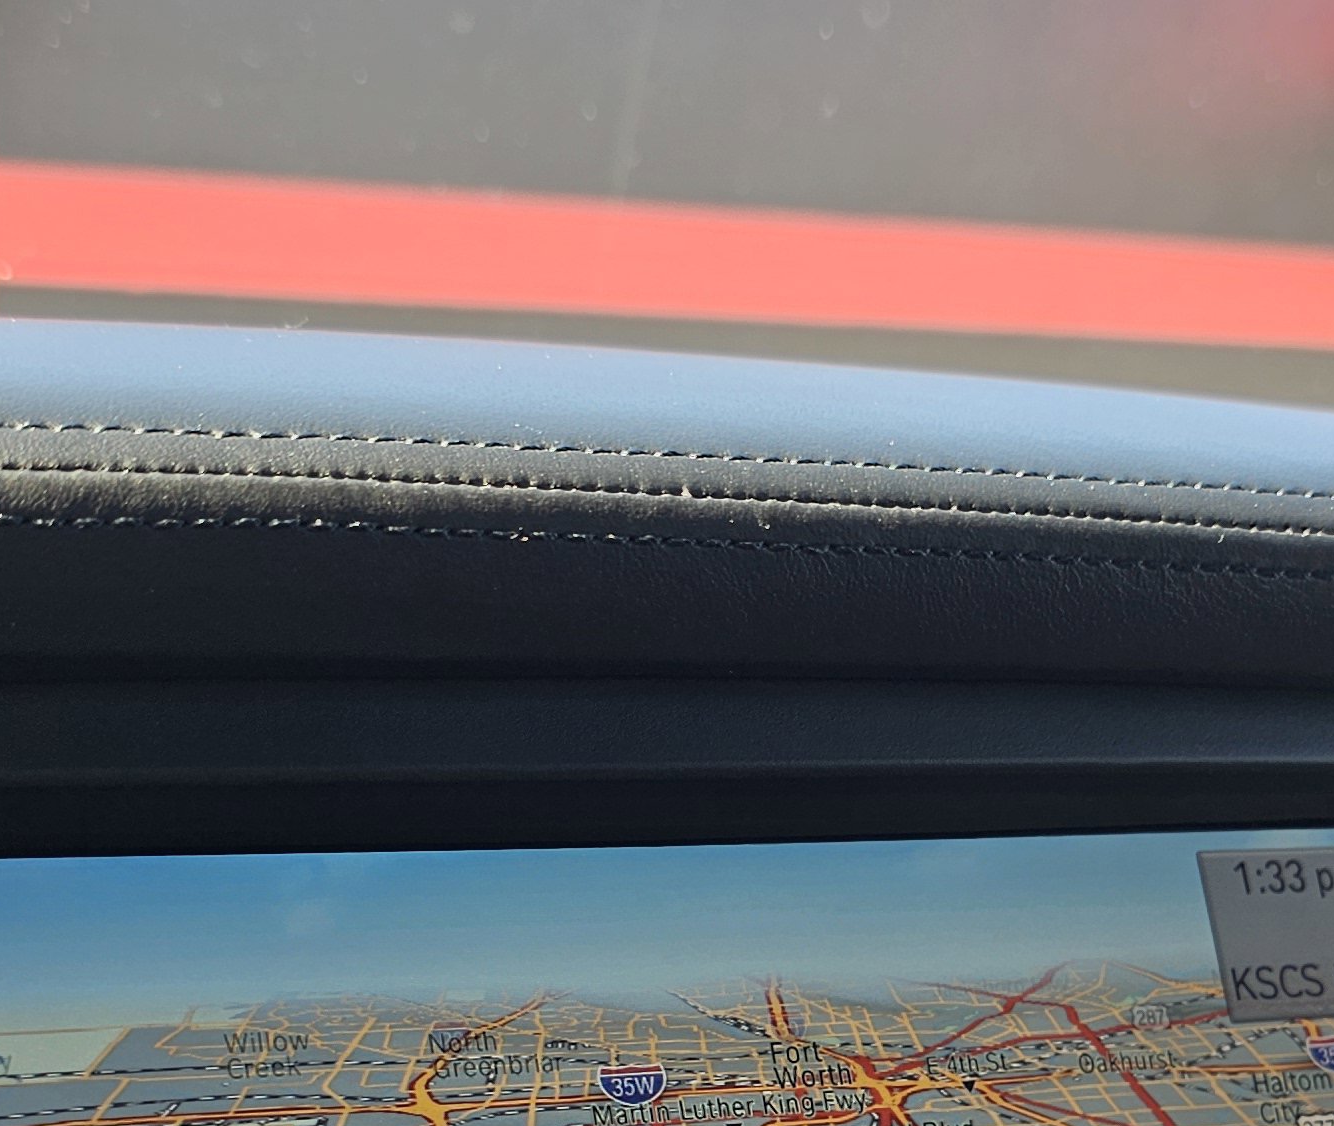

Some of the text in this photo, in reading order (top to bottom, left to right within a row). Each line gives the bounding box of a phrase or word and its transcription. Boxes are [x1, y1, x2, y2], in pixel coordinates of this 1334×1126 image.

[1233, 859, 1307, 896] 1:33
[1230, 963, 1326, 1001] KSCS
[1135, 1006, 1166, 1026] 287
[223, 1029, 310, 1054] Willow
[428, 1030, 498, 1055] North
[770, 1041, 824, 1066] Fort
[226, 1056, 303, 1080] Creek
[433, 1055, 566, 1080] Greenbriar
[926, 1052, 1010, 1076] E 4th St
[1078, 1050, 1176, 1075] Oakhurst
[610, 1075, 656, 1098] 35W
[774, 1064, 853, 1090] Worth
[1251, 1070, 1334, 1095] Haltom
[592, 1089, 868, 1126] Martin Luther King Fwy
[1260, 1101, 1301, 1126] City
